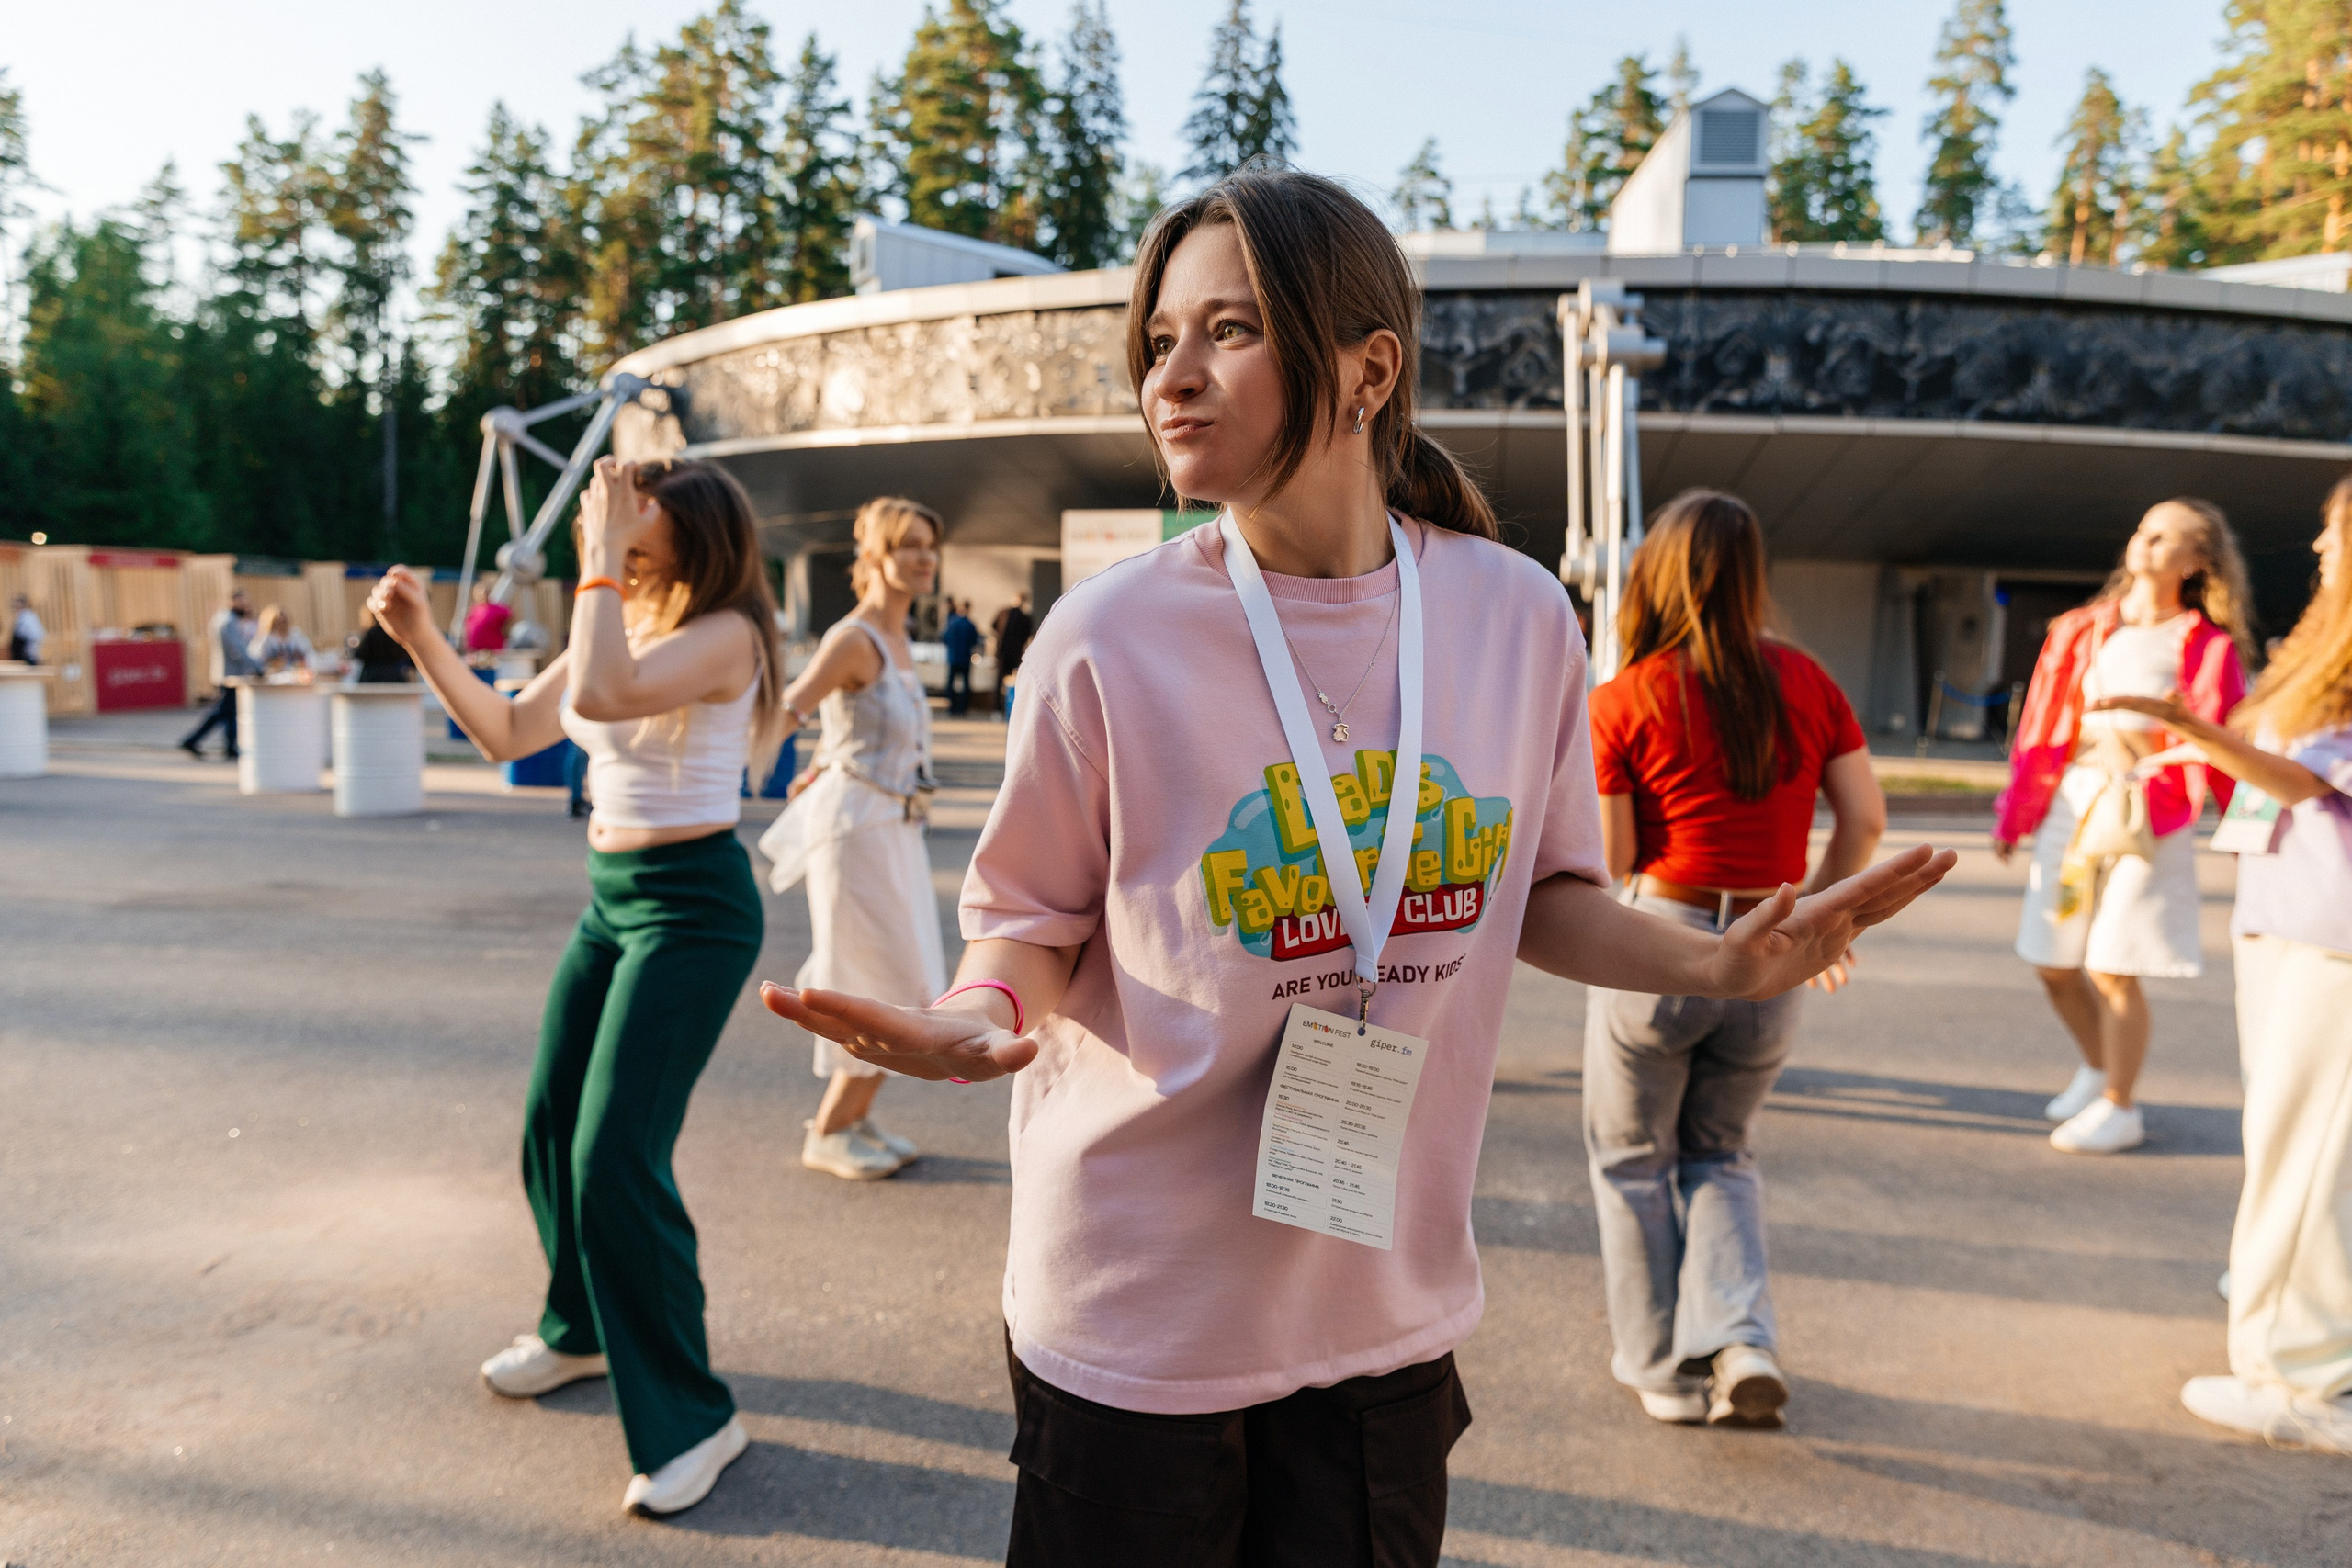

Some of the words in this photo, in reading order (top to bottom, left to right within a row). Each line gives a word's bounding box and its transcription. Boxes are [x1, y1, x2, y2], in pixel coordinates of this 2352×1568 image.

[1404, 887, 1476, 923] CLUB
[1272, 976, 1311, 1000] ARE
[1317, 969, 1353, 990] YOU
[1313, 1038, 1334, 1048] WELCOME
[1334, 1029, 1351, 1039] FEST
[1369, 1039, 1413, 1056] giper.fm
[1279, 1083, 1313, 1096] ФЕСТИВАЛЬНАЯ
[1314, 1092, 1340, 1103] ПРОГРАММА
